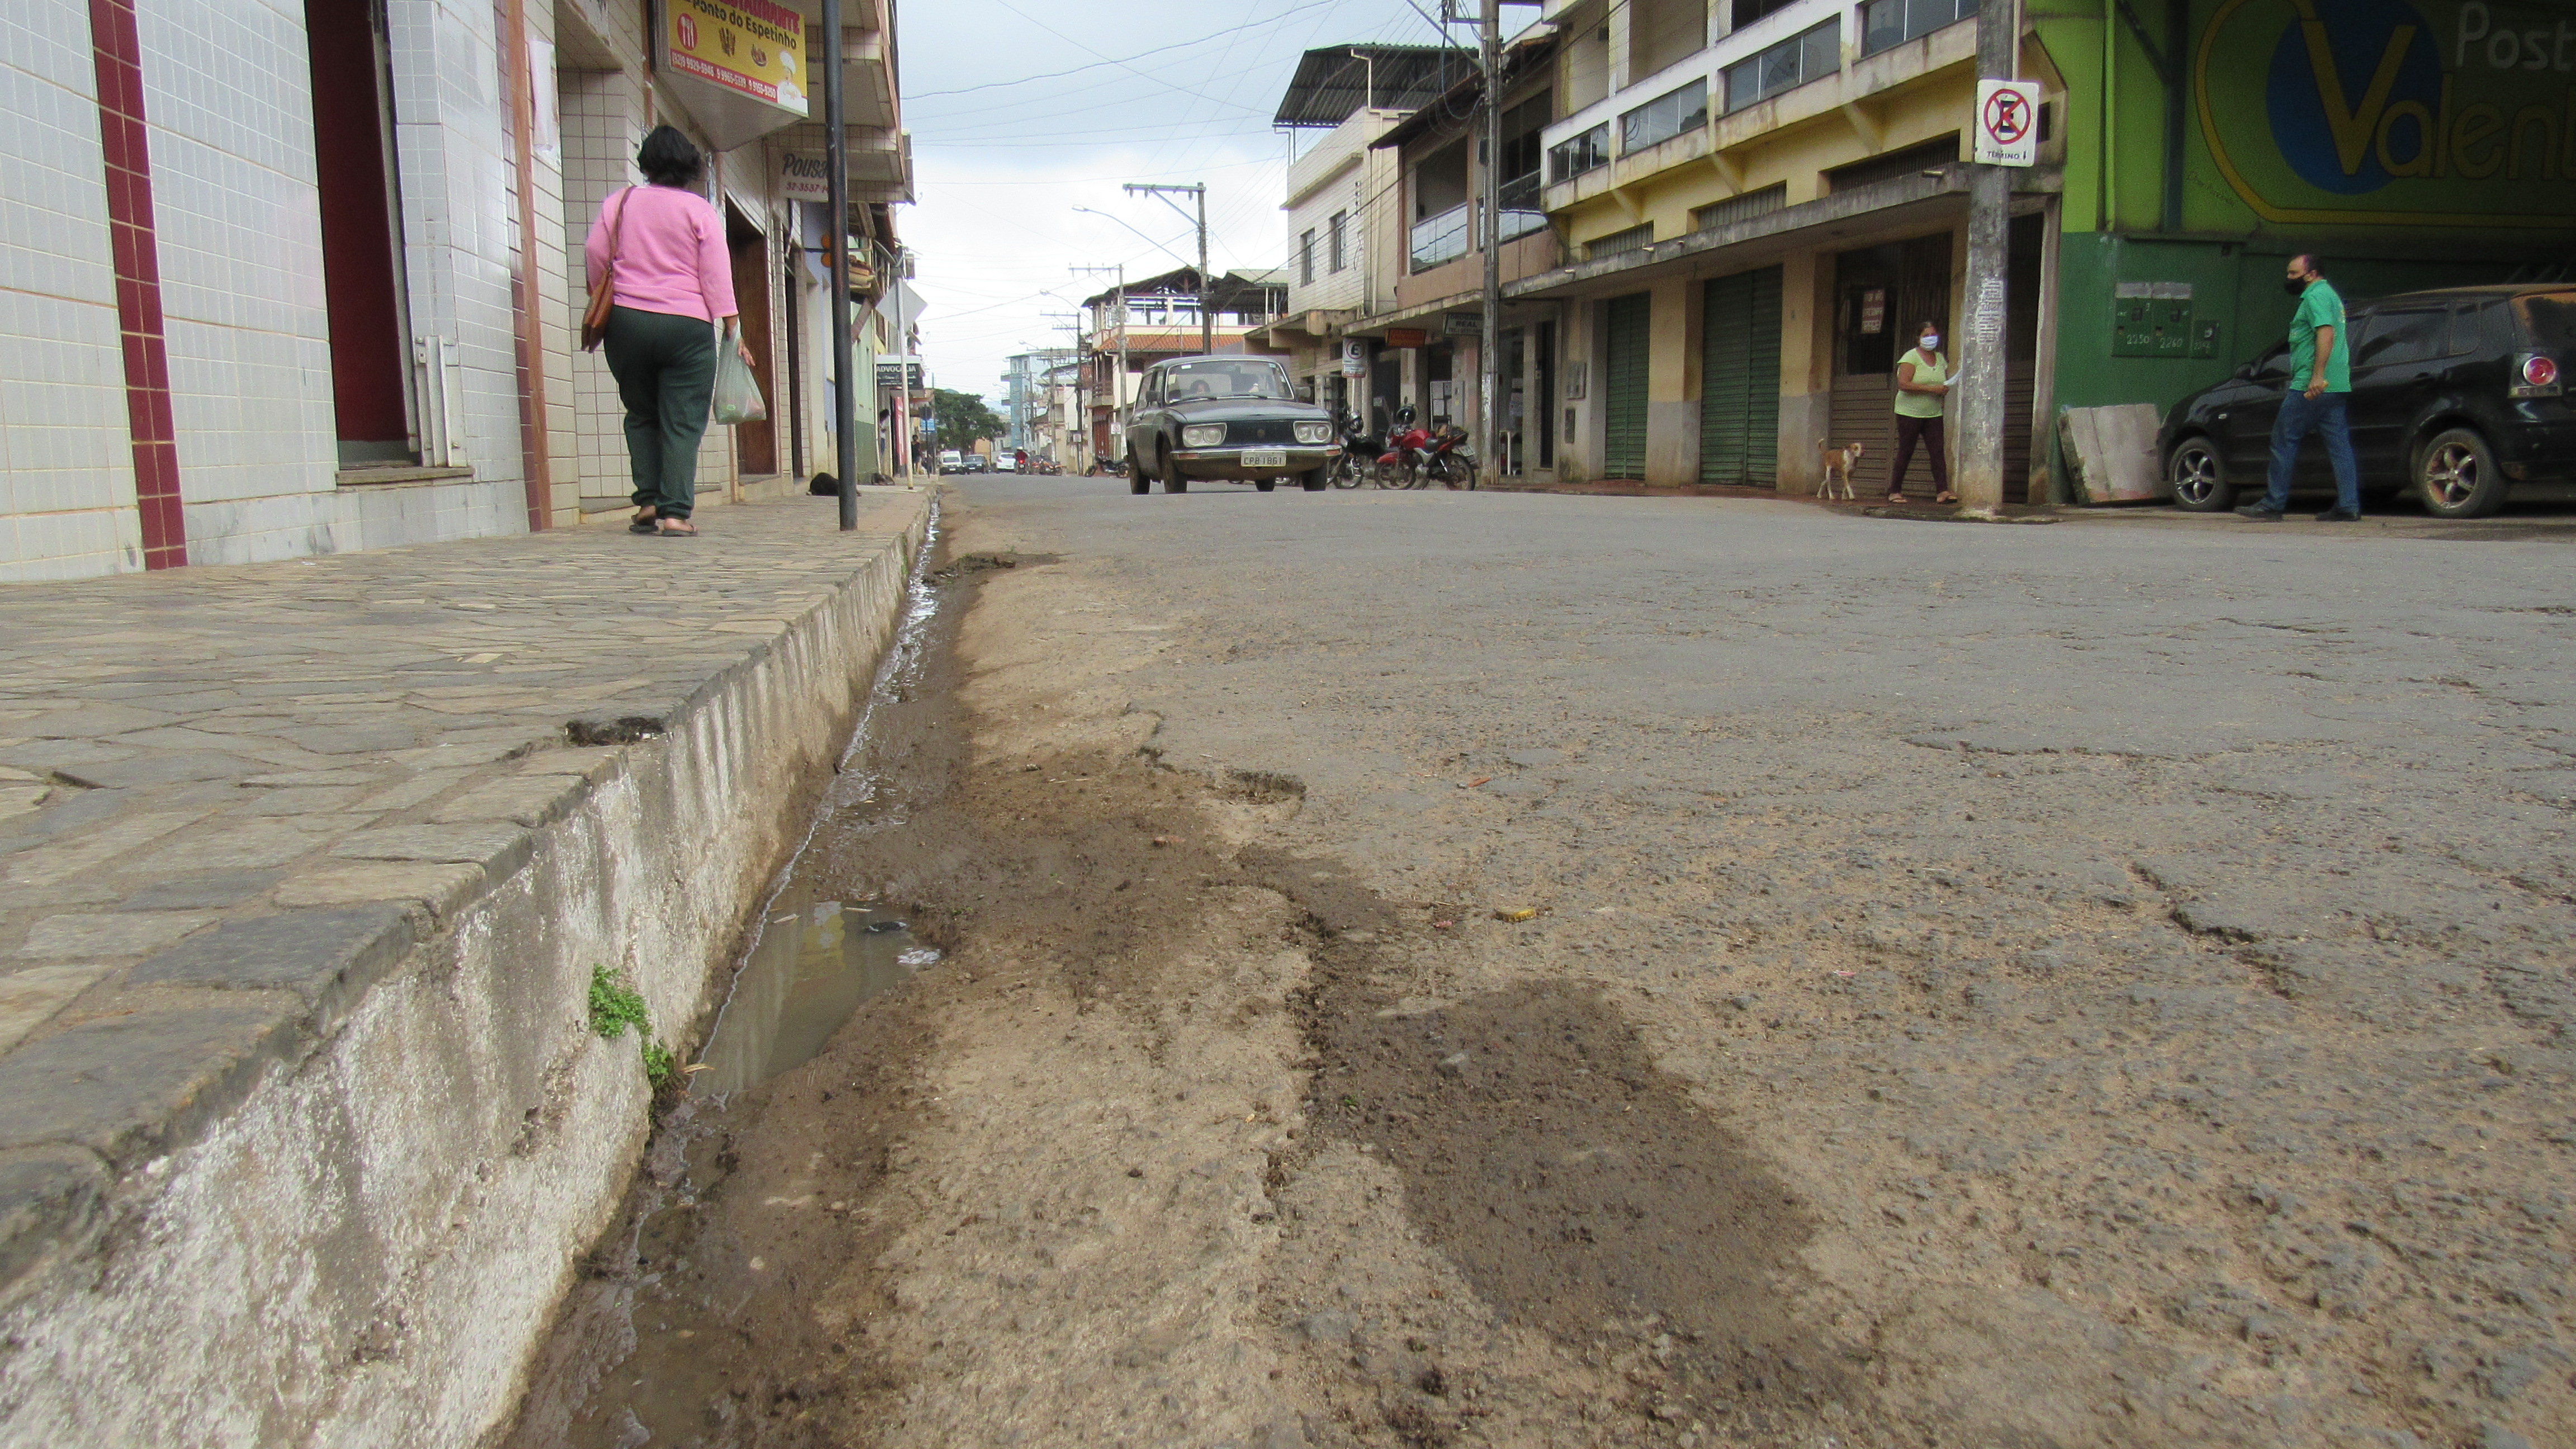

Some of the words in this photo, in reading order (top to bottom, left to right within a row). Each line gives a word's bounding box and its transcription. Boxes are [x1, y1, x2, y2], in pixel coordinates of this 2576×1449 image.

[693, 0, 727, 21] Ponto
[729, 10, 743, 28] do
[746, 16, 797, 50] Espetinho
[718, 0, 800, 35] TAURANTE
[783, 153, 828, 178] Pousa
